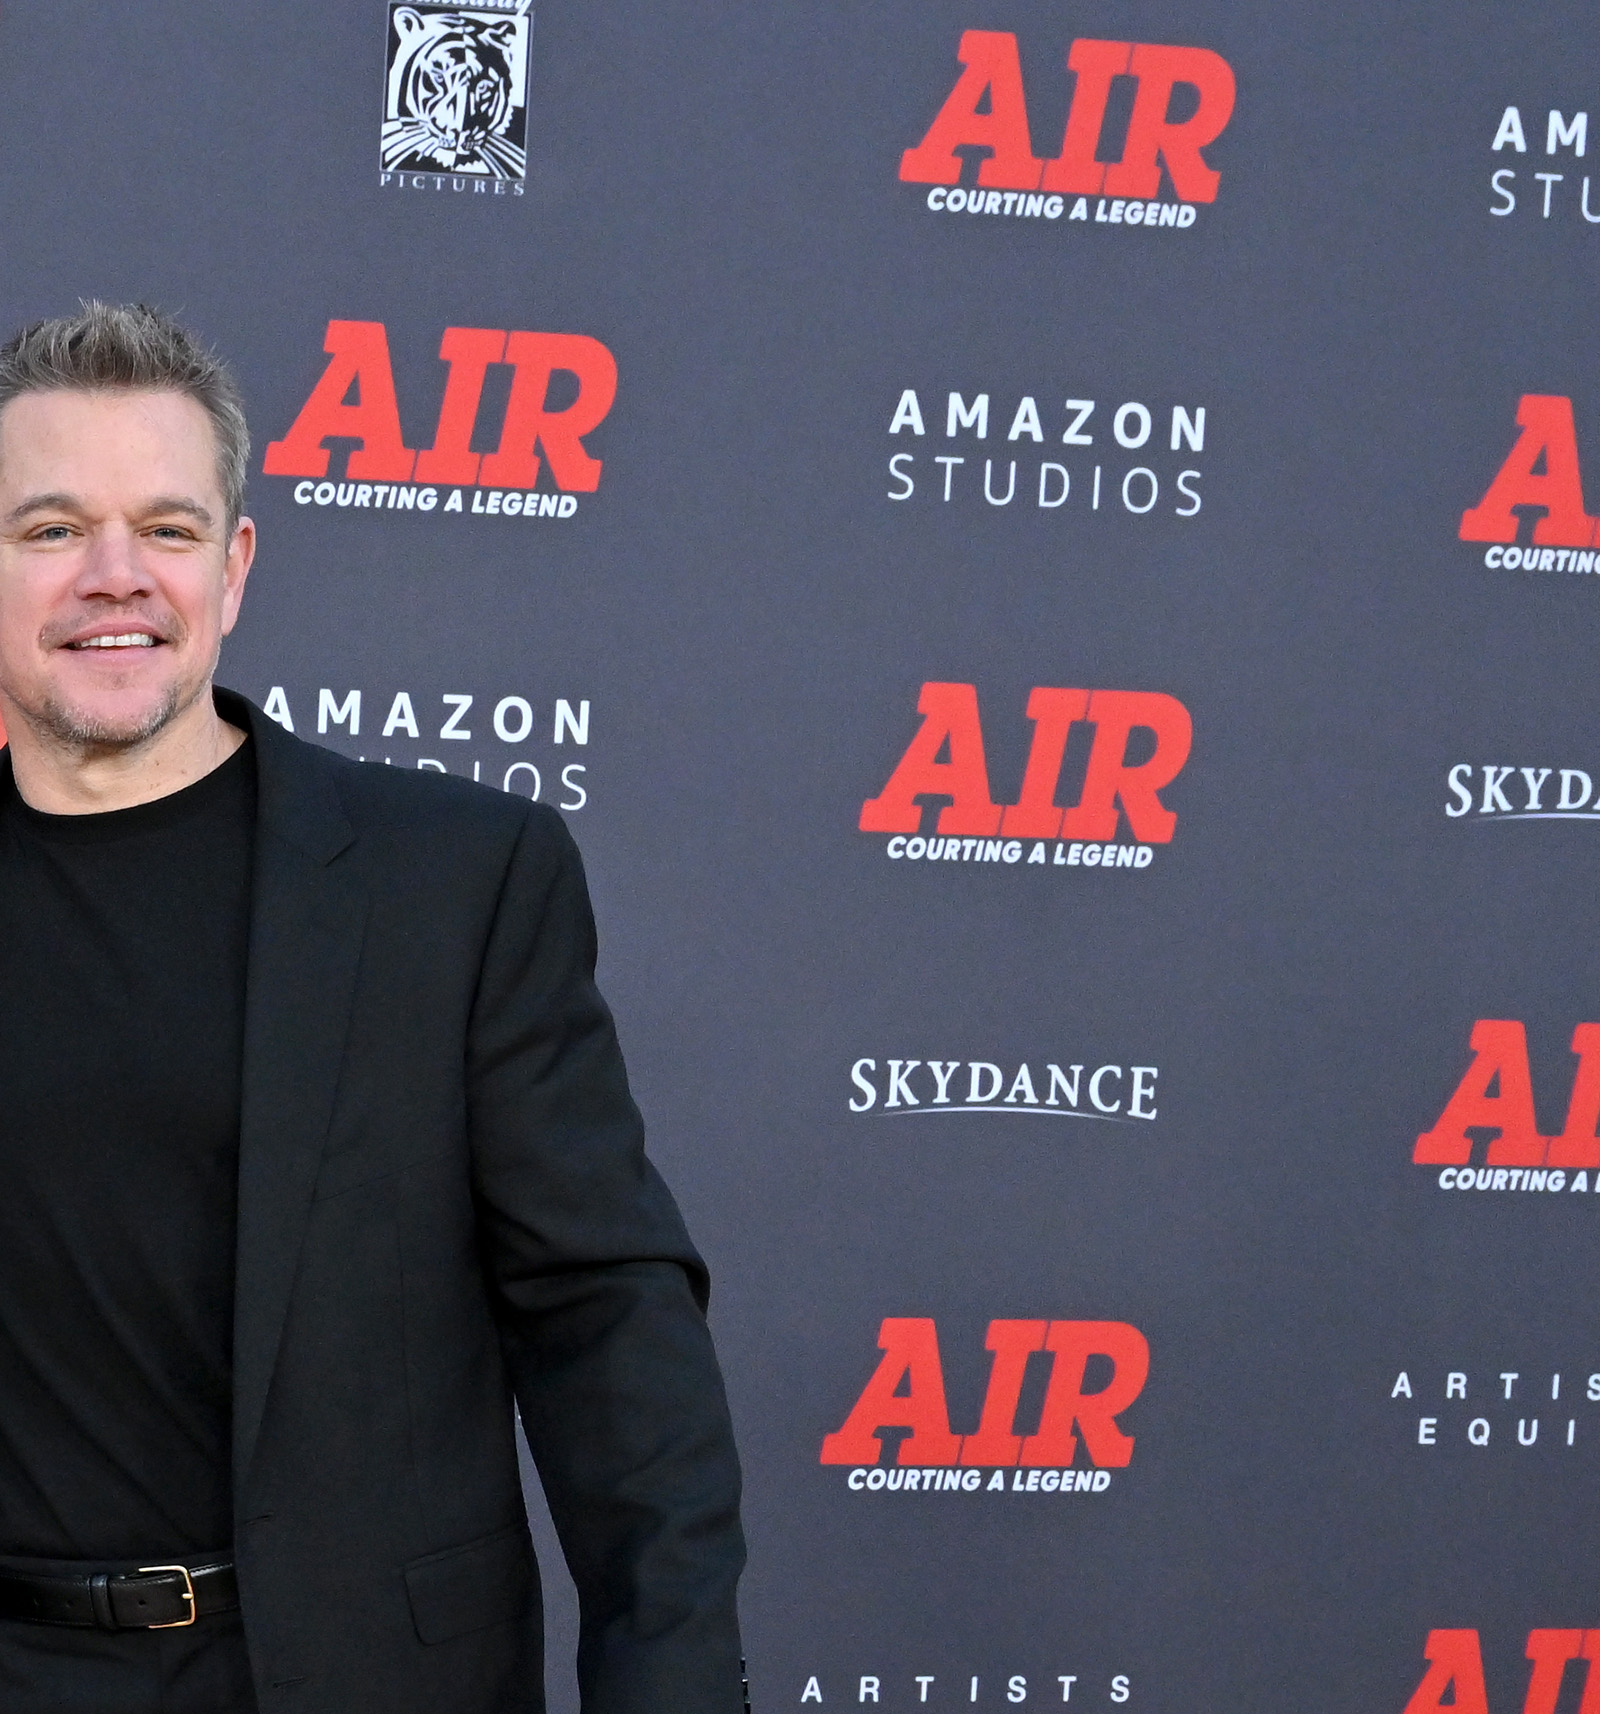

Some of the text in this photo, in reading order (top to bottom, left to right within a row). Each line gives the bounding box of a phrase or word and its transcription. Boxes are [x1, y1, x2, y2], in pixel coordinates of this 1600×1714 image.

[899, 30, 1235, 203] AIR
[381, 174, 524, 195] PICTURES
[927, 187, 1196, 228] COURTING A LEGEND
[264, 320, 617, 492] AIR
[889, 390, 1205, 451] AMAZON
[294, 481, 577, 518] COURTING A LEGEND
[888, 453, 1201, 516] STUDIOS
[263, 686, 590, 745] AMAZON
[859, 682, 1192, 843] AIR
[1445, 764, 1600, 817] SKYD
[887, 836, 1153, 868] COURTING A LEGEND
[849, 1059, 1158, 1120] SKYDANCE
[1439, 1168, 1565, 1192] COURTING
[1571, 1171, 1587, 1192] A
[820, 1318, 1149, 1467] AIR
[848, 1469, 1110, 1491] COURTING A LEGEND
[801, 1675, 1129, 1702] ARTISTS
